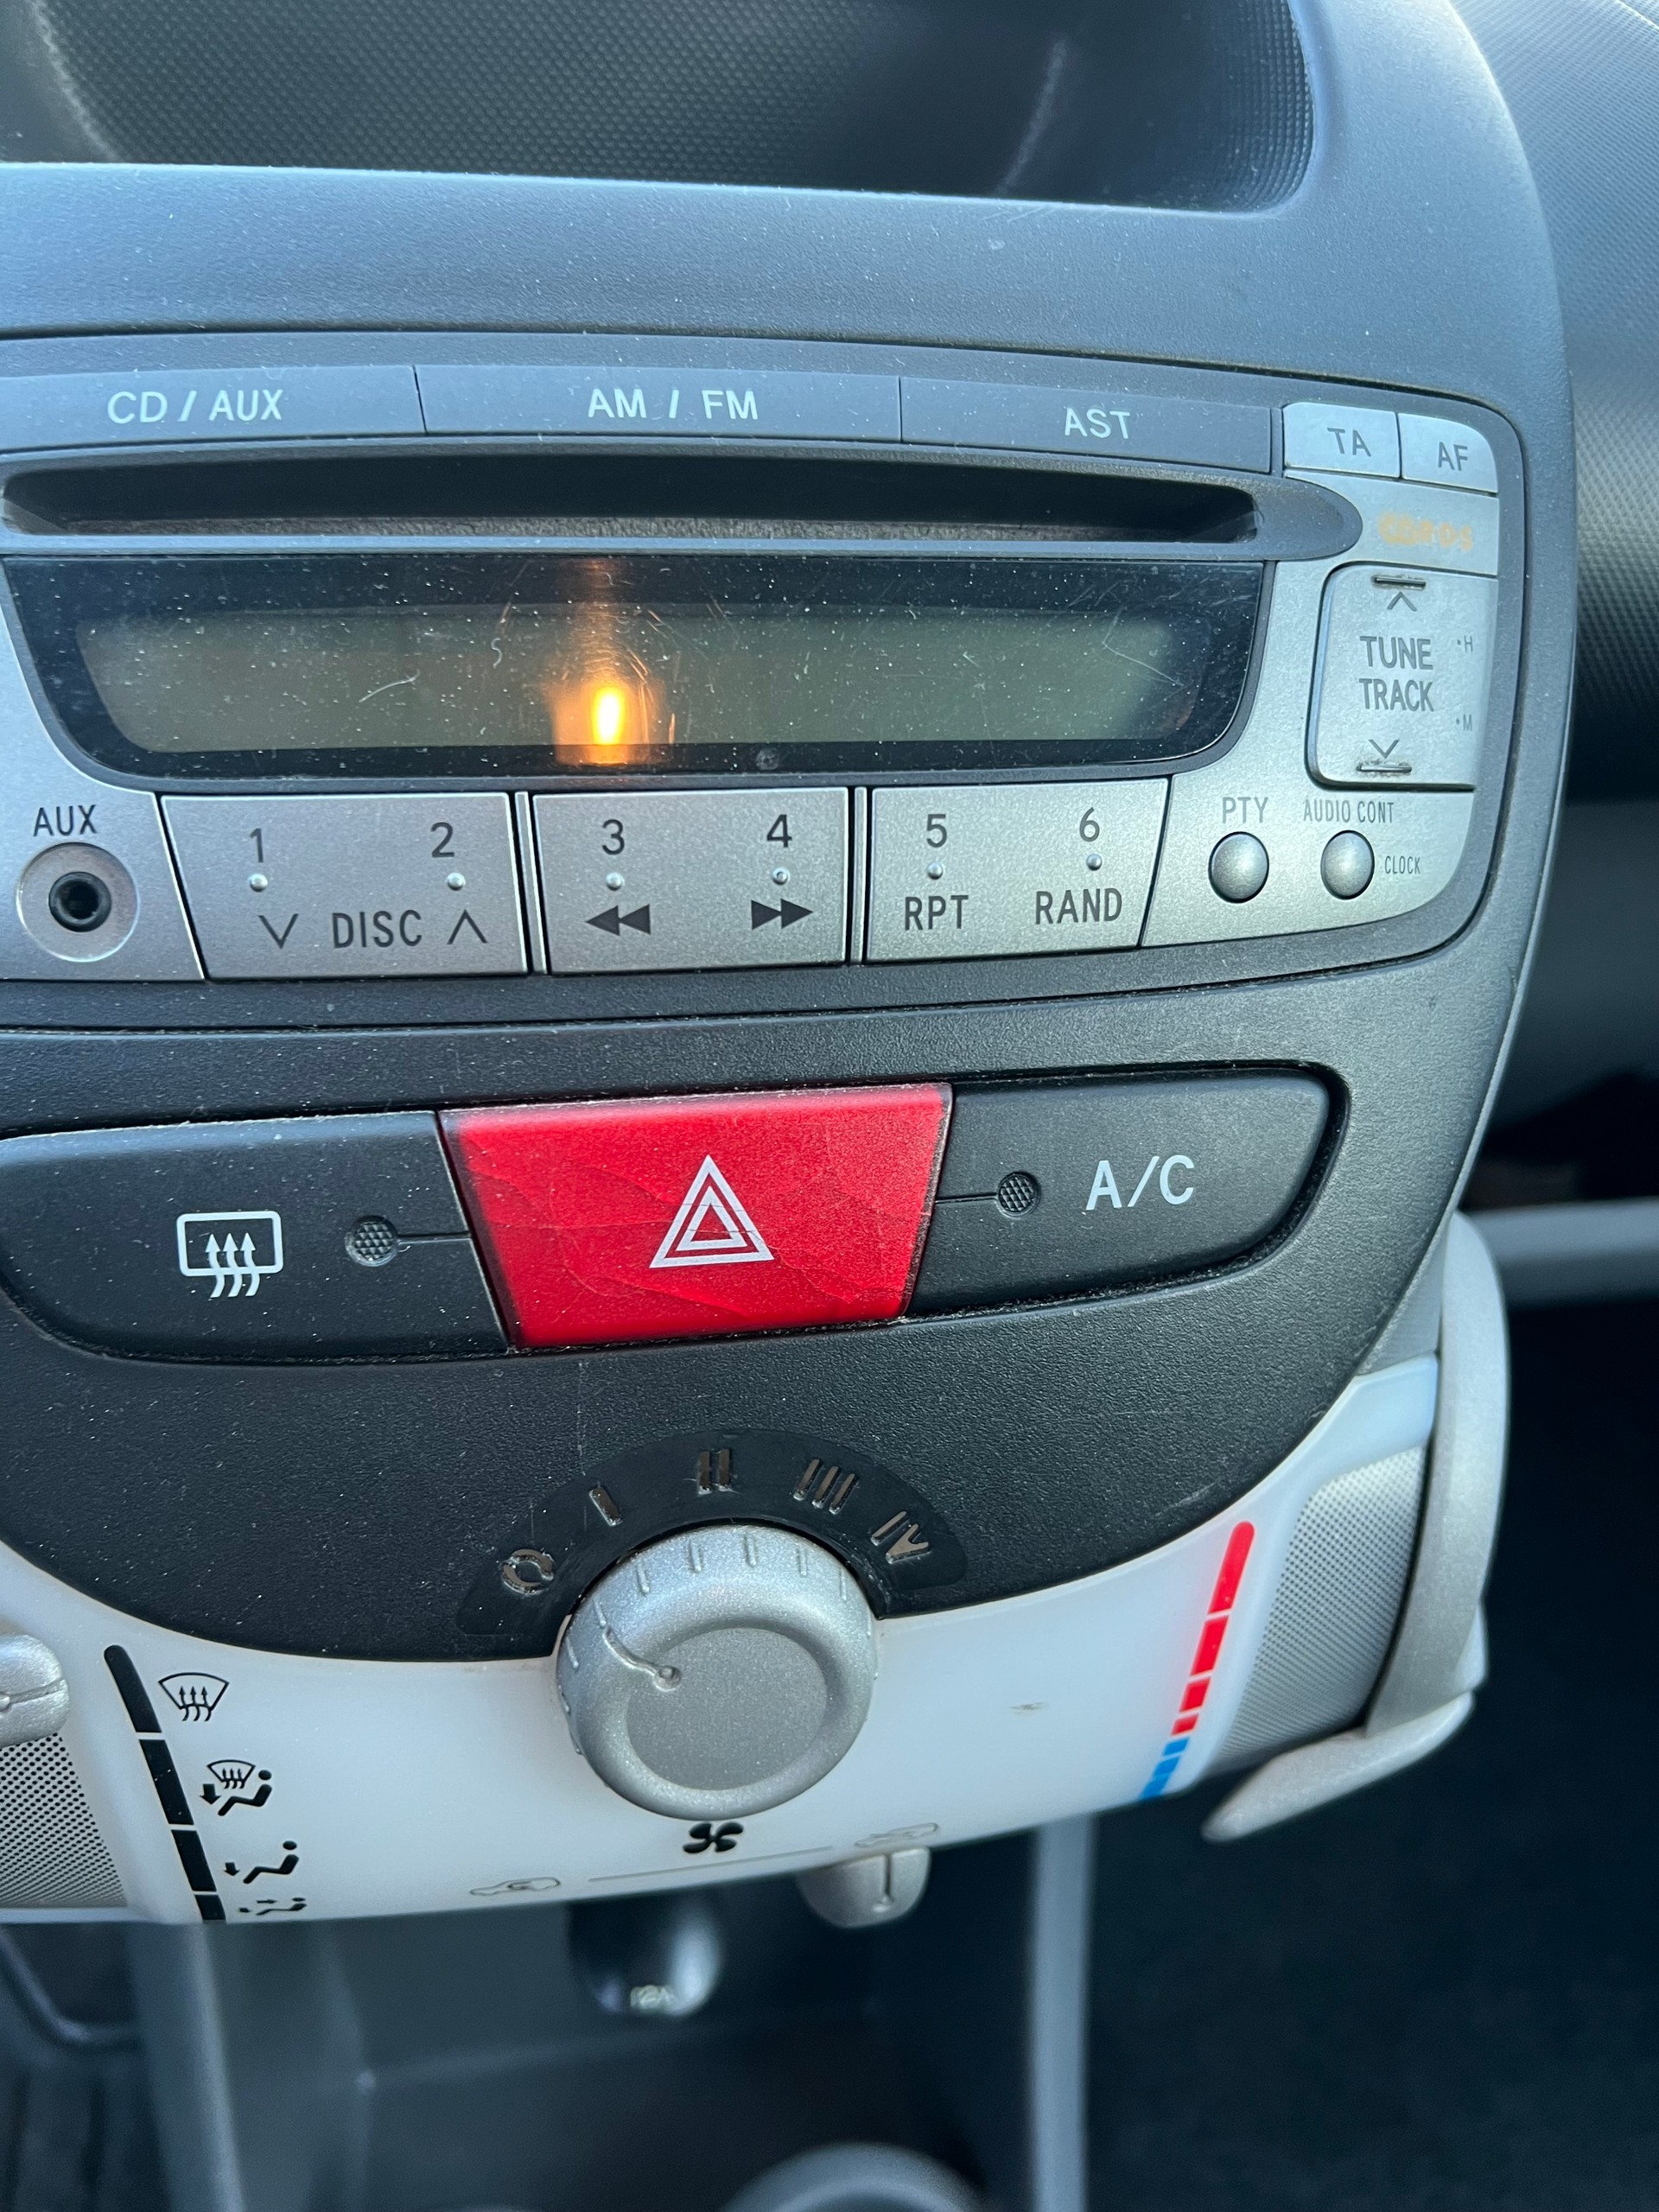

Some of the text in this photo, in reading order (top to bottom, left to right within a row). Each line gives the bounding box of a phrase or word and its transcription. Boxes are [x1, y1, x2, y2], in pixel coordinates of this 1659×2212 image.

[107, 391, 168, 424] CD
[209, 389, 283, 422] AUX
[588, 388, 646, 418] AM
[702, 390, 758, 420] FM
[1065, 407, 1130, 439] AST
[1326, 427, 1372, 457] TA
[1438, 442, 1468, 472] AF
[1359, 635, 1433, 671] TUNE
[1358, 677, 1434, 712] TRACK
[33, 804, 97, 837] AUX
[1078, 806, 1100, 842] 6
[1222, 796, 1269, 824] PTY
[1303, 798, 1395, 823] AUDIO CONT
[250, 828, 264, 863] 1
[430, 822, 455, 858] 2
[601, 818, 625, 855] 3
[766, 814, 792, 849] 4
[926, 813, 948, 849] 5
[1384, 855, 1421, 875] CLOCK
[904, 894, 969, 931] RPT
[1035, 887, 1122, 925] RAND
[332, 909, 423, 949] DISC
[1085, 1154, 1195, 1211] A/C
